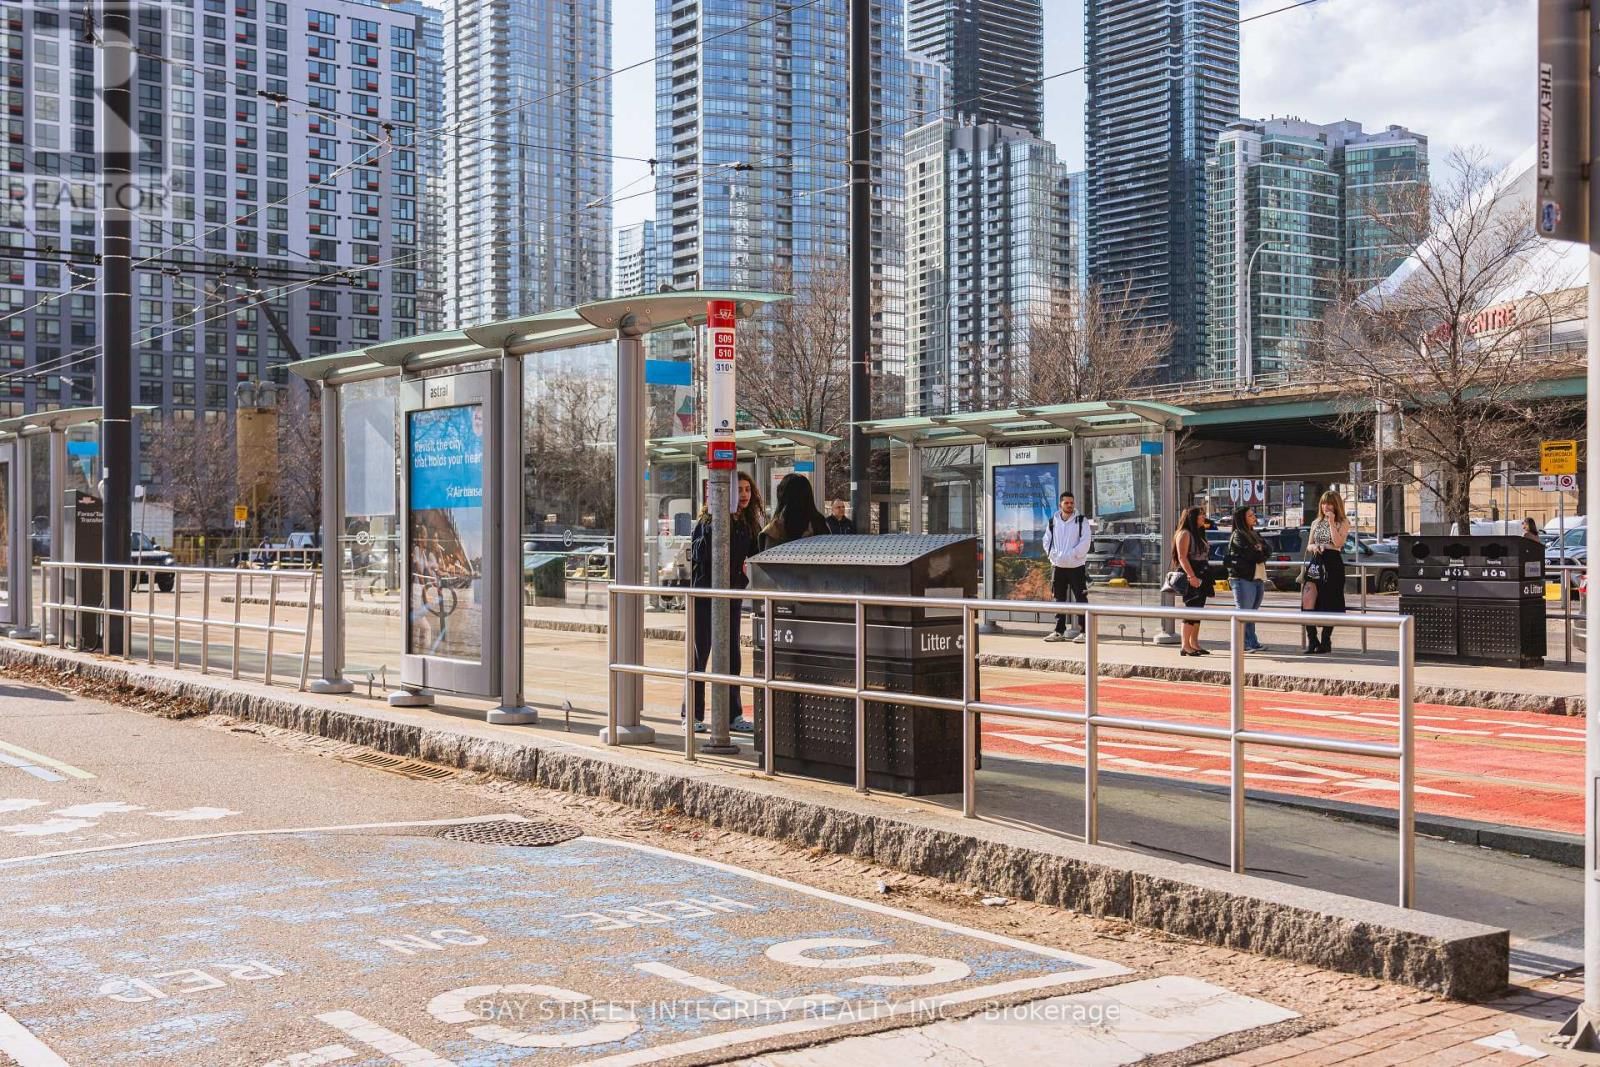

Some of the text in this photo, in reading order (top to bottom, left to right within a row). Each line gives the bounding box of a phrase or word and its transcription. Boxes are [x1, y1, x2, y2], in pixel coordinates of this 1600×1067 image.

[718, 334, 732, 343] 509
[718, 349, 732, 358] 510
[430, 384, 448, 399] astral
[436, 438, 448, 451] the
[1015, 451, 1031, 460] astral
[428, 454, 446, 467] holds
[448, 455, 463, 470] your
[1530, 584, 1543, 595] Litter
[920, 632, 951, 652] Litter
